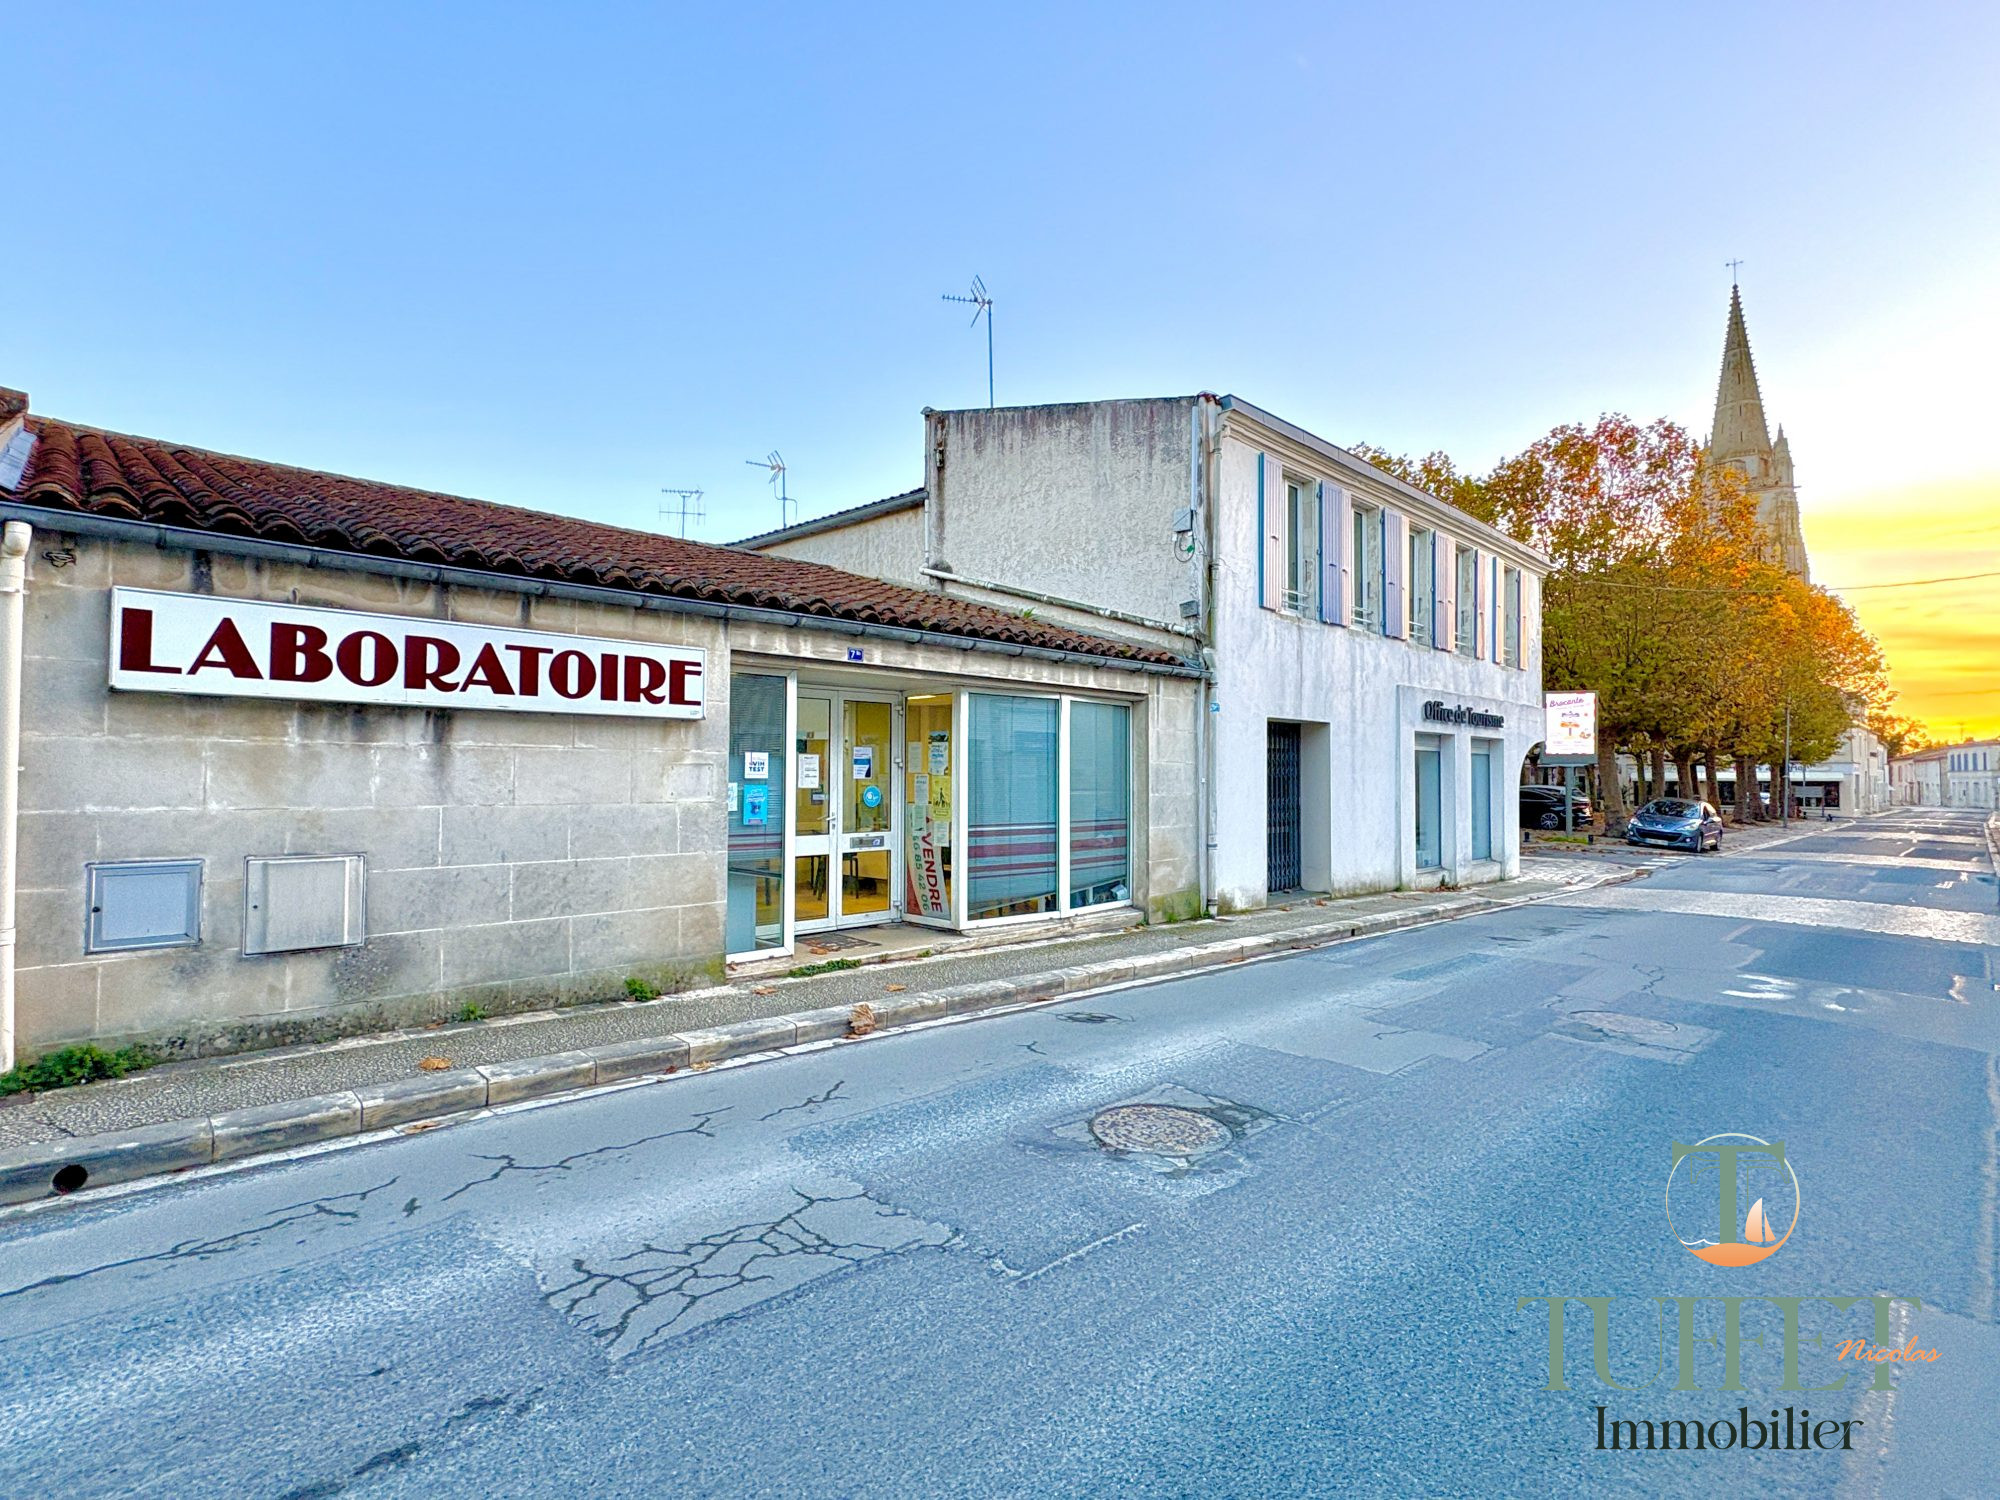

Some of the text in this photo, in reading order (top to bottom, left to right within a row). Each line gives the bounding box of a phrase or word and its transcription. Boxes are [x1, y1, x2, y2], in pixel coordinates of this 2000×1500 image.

[120, 607, 702, 706] LABORATOIRE
[1424, 700, 1504, 728] Office de Tourisme
[1549, 697, 1584, 707] Brocante
[921, 831, 943, 913] VENDRE
